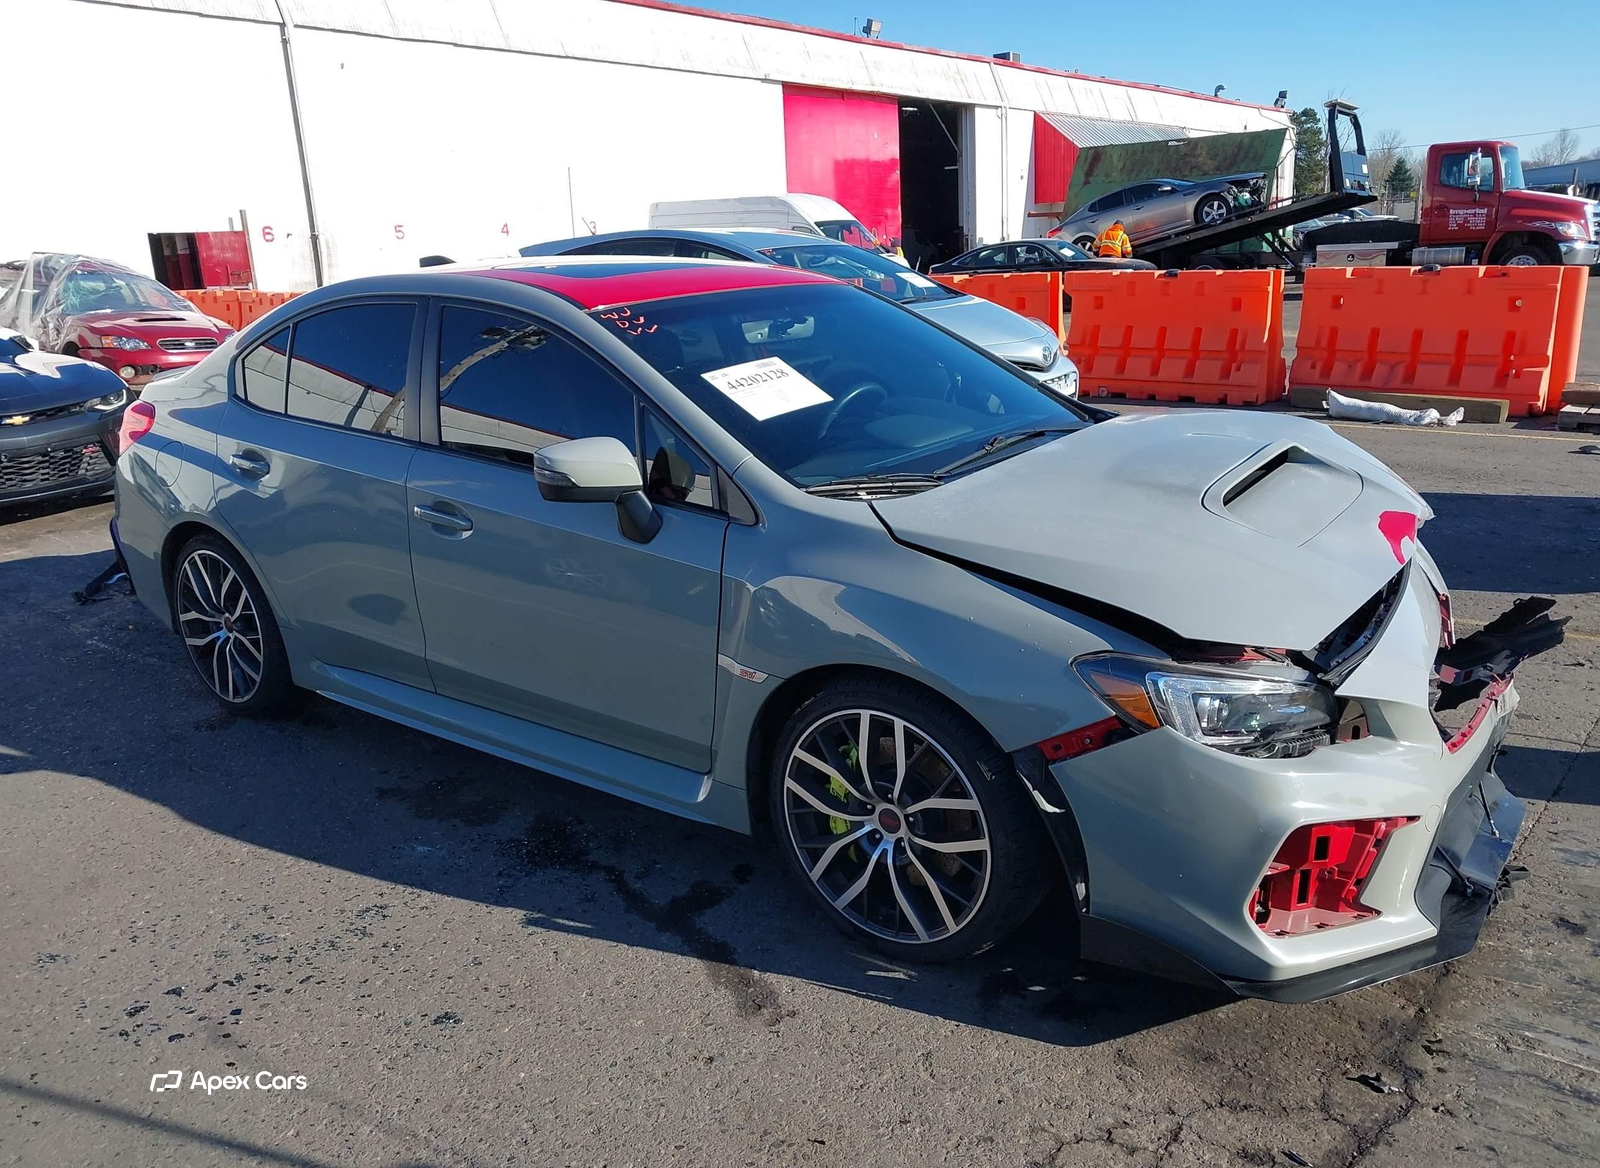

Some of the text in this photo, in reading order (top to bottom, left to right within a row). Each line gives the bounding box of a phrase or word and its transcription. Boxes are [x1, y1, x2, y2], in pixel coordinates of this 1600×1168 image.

[262, 225, 275, 243] 6
[394, 224, 405, 240] 5
[501, 222, 510, 237] 4
[726, 368, 789, 390] 44202128
